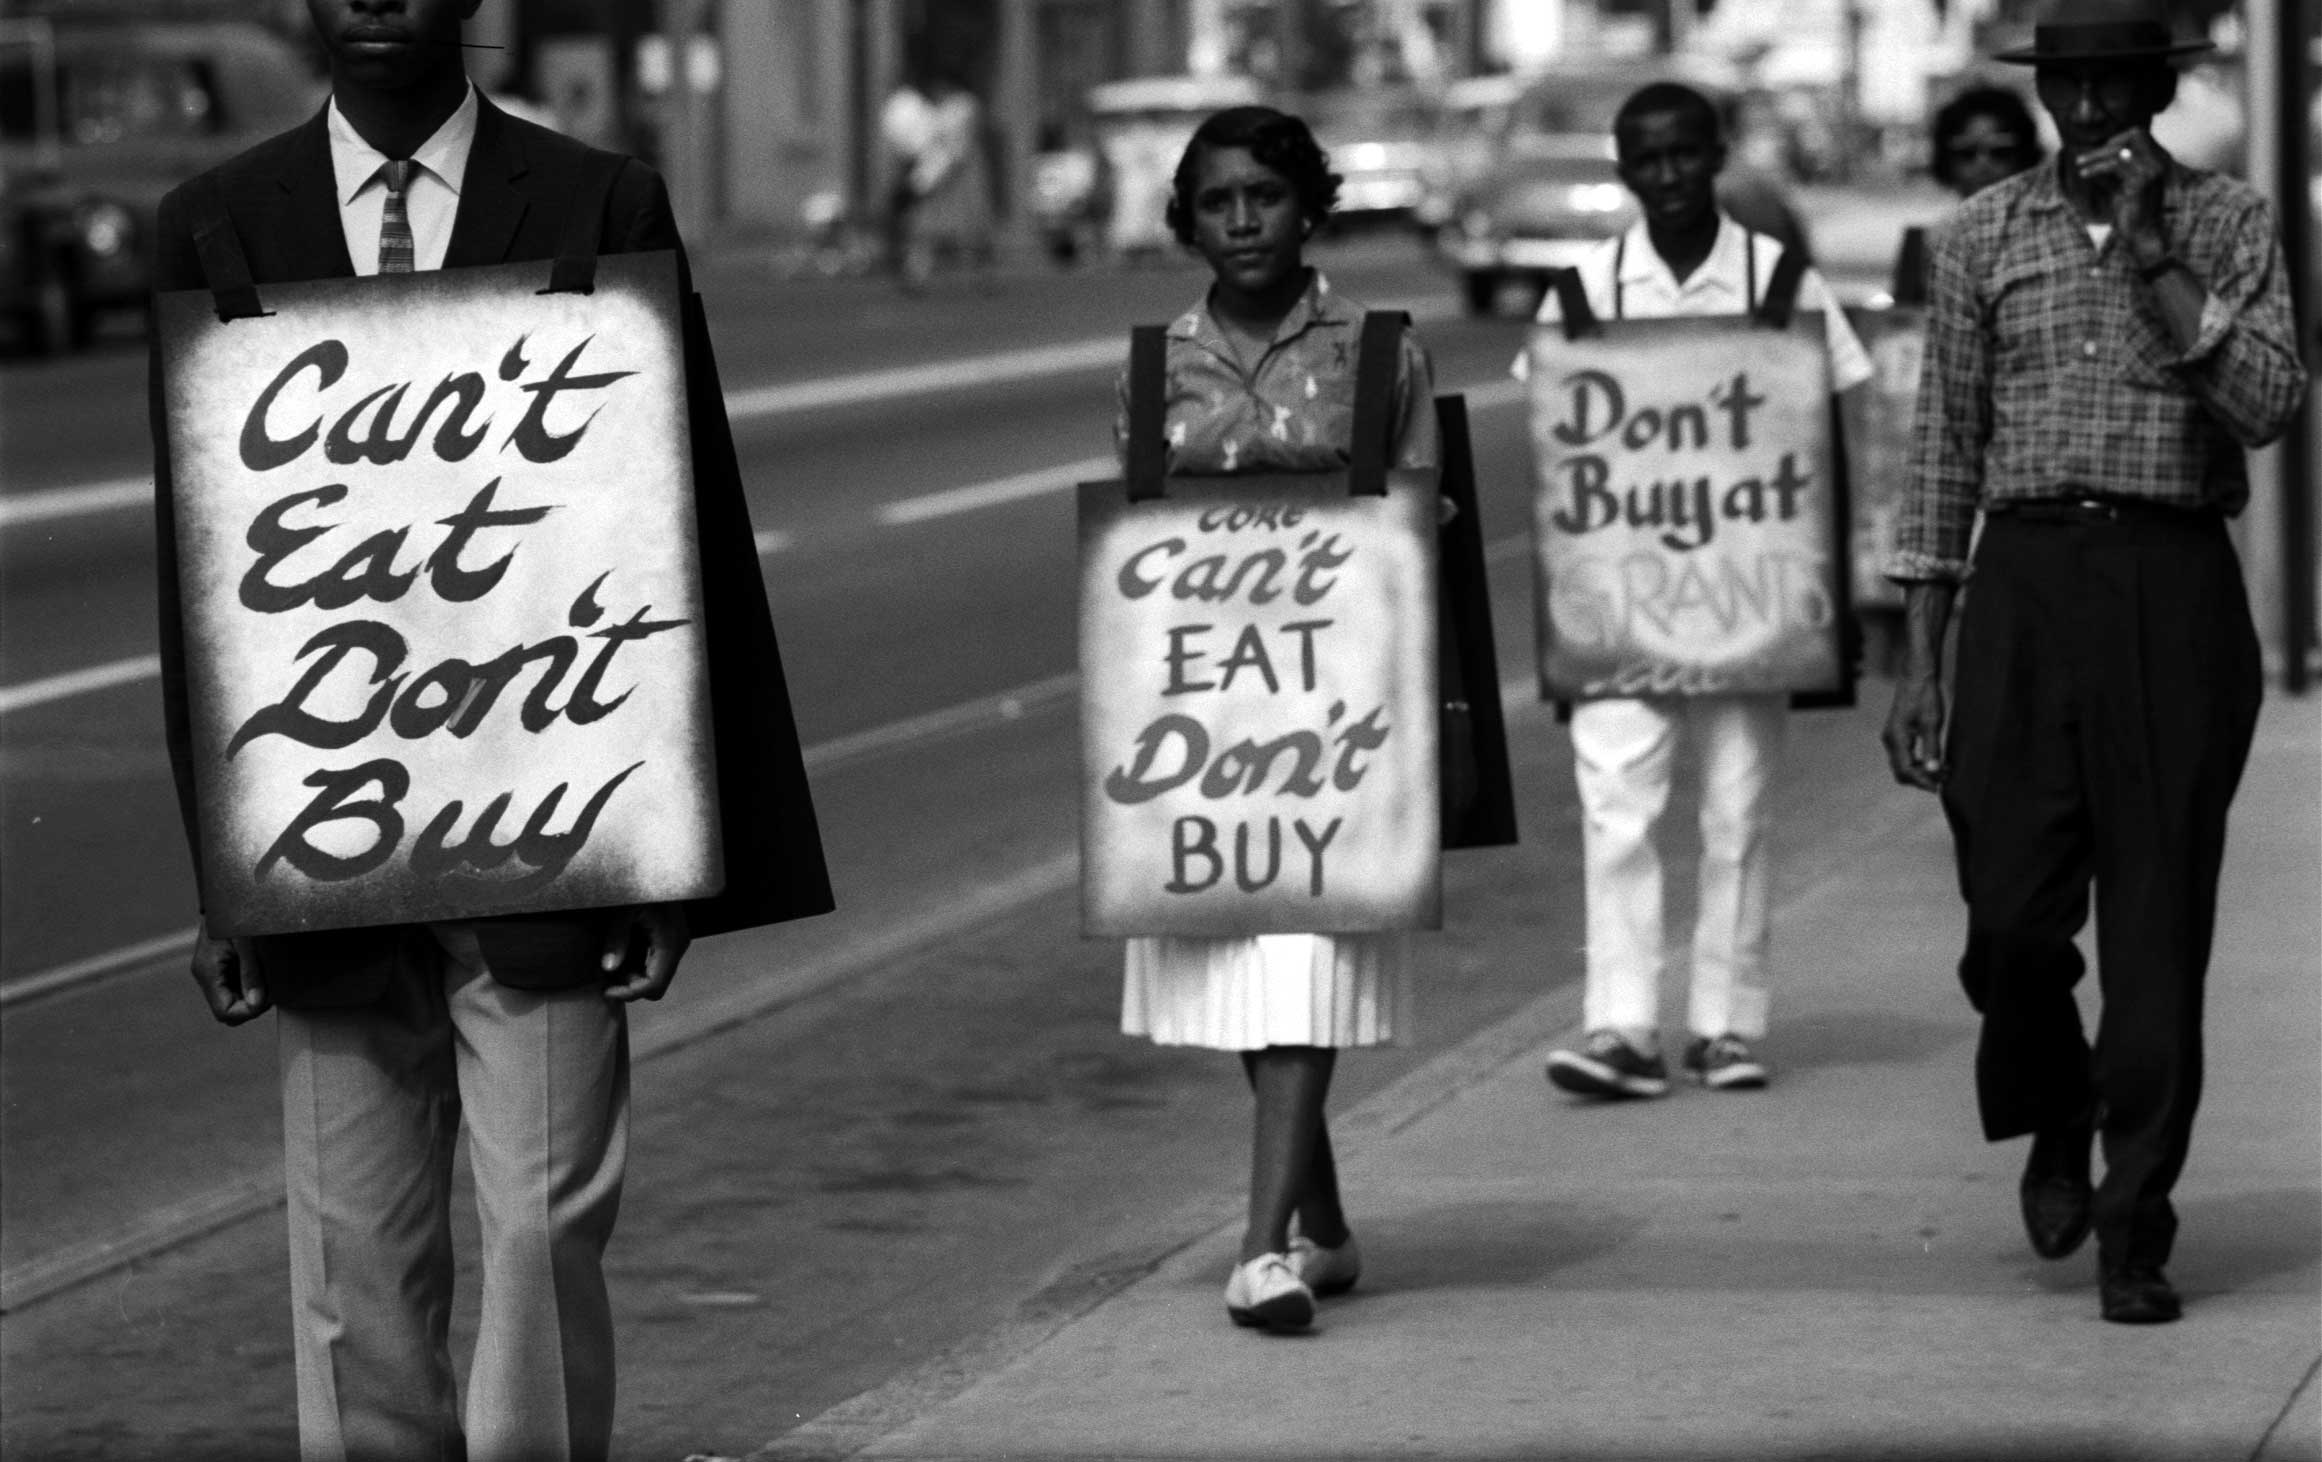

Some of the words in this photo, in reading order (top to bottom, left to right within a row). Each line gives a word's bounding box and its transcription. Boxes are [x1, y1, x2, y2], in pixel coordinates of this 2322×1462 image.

[239, 334, 641, 471] Can't
[1553, 370, 1766, 452] Don't
[238, 476, 566, 614] Eat
[1552, 455, 1714, 551] Buy
[1722, 453, 1811, 523] at
[1118, 529, 1353, 605] Can't
[226, 570, 692, 761] Don't
[1161, 619, 1334, 695] EAT
[1105, 700, 1390, 804] Don't
[254, 758, 646, 895] Buy
[1164, 815, 1342, 897] BUY
